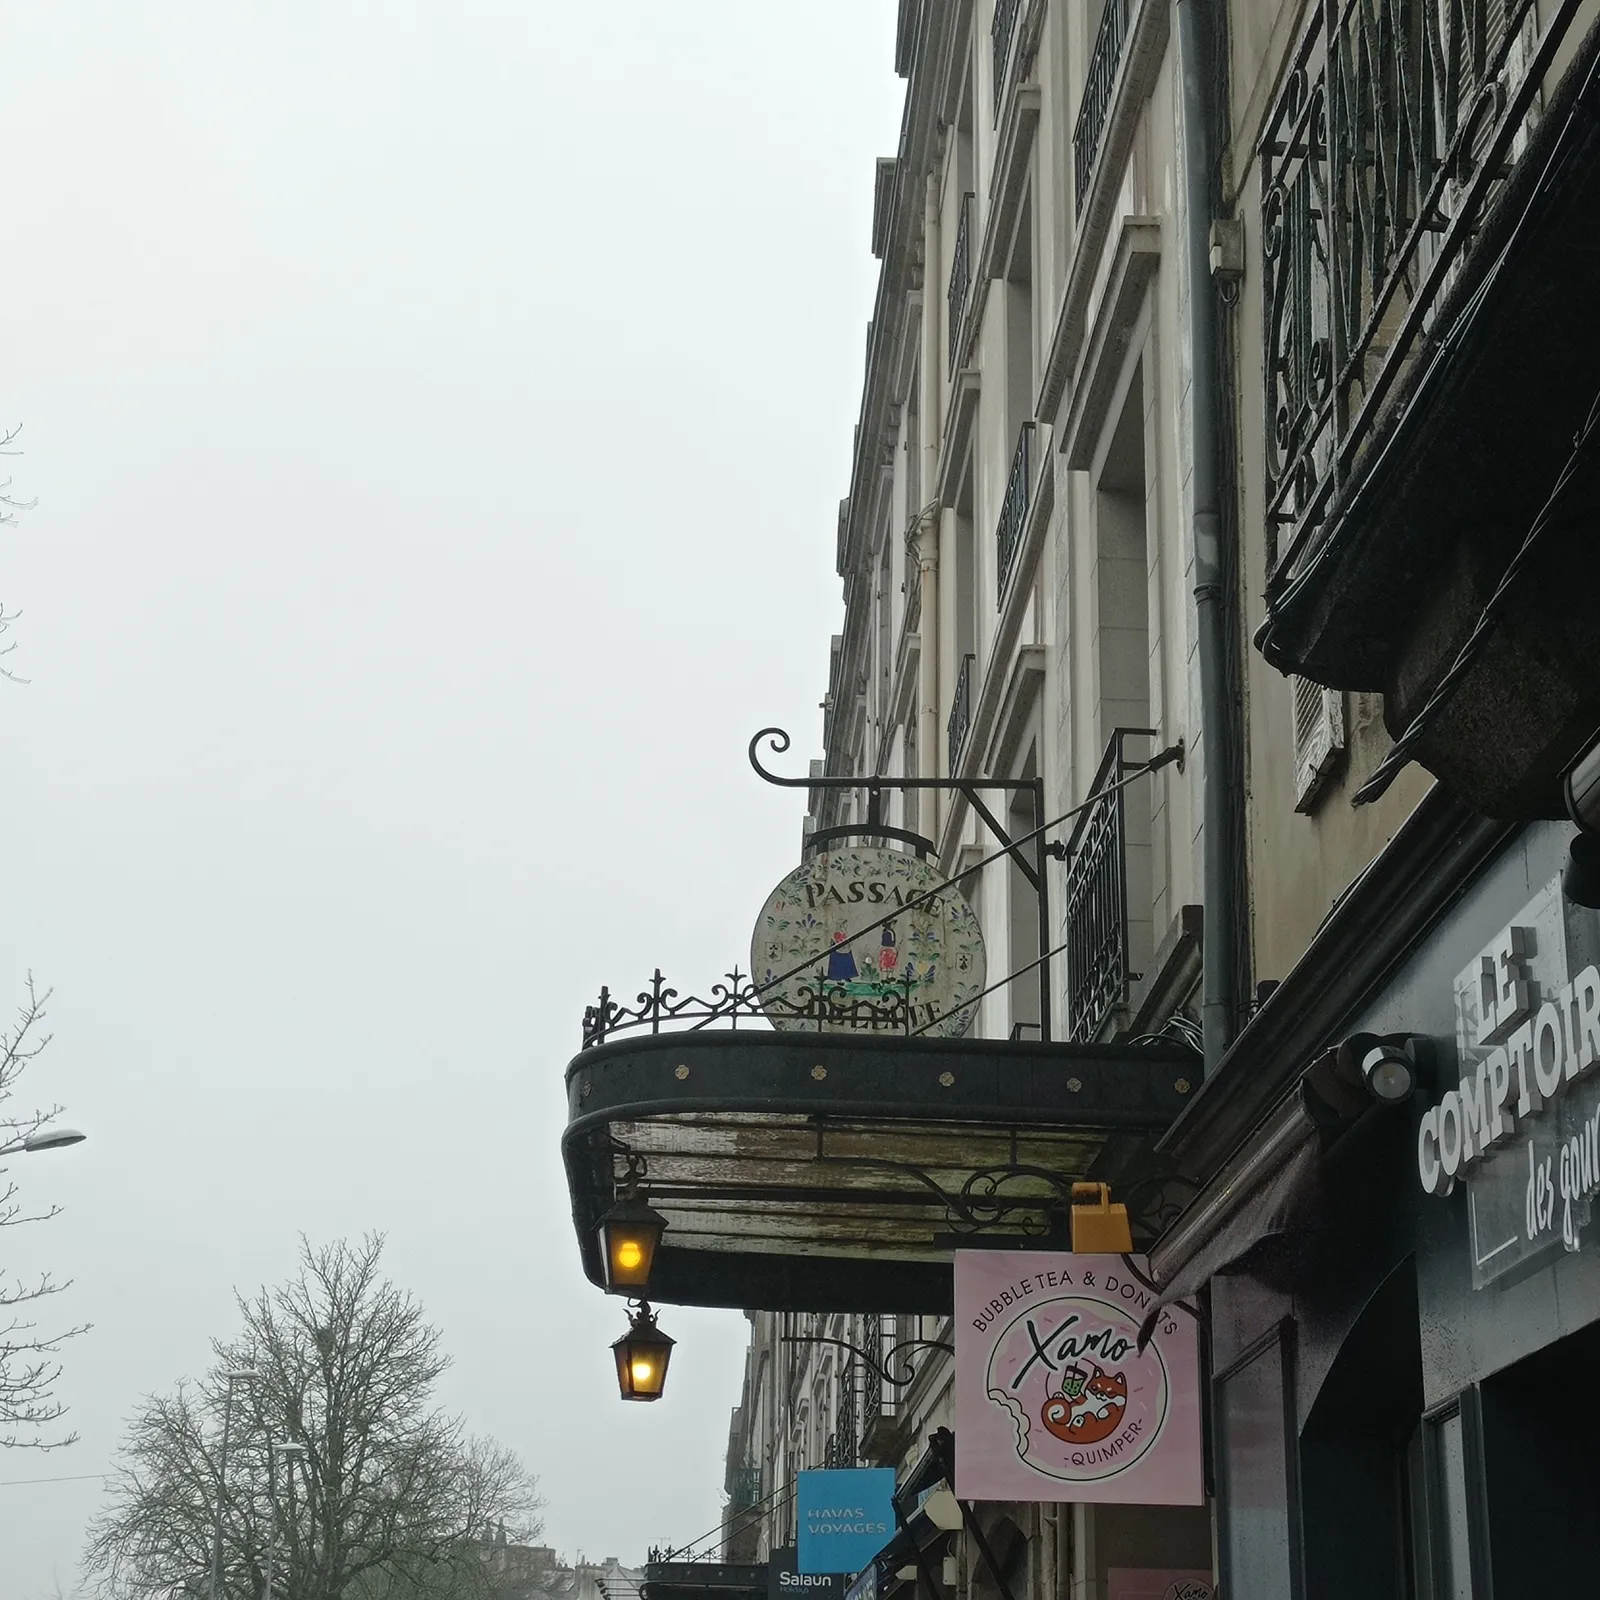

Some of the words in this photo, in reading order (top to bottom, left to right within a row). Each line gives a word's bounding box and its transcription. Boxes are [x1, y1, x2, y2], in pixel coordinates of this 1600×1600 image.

[805, 881, 945, 918] PASSAGE
[1474, 926, 1529, 1046] LE
[1418, 965, 1600, 1195] COMPTOIR
[1526, 1138, 1555, 1241] des
[972, 1278, 1034, 1333] BUBBLE
[1034, 1270, 1074, 1290] TEA
[1083, 1271, 1096, 1287] &
[1104, 1275, 1179, 1335] DONTS
[1011, 1315, 1136, 1389] Xamo
[808, 1507, 865, 1519] HAVAS
[808, 1522, 887, 1534] VOYAGES
[1172, 1583, 1209, 1600] Xamo
